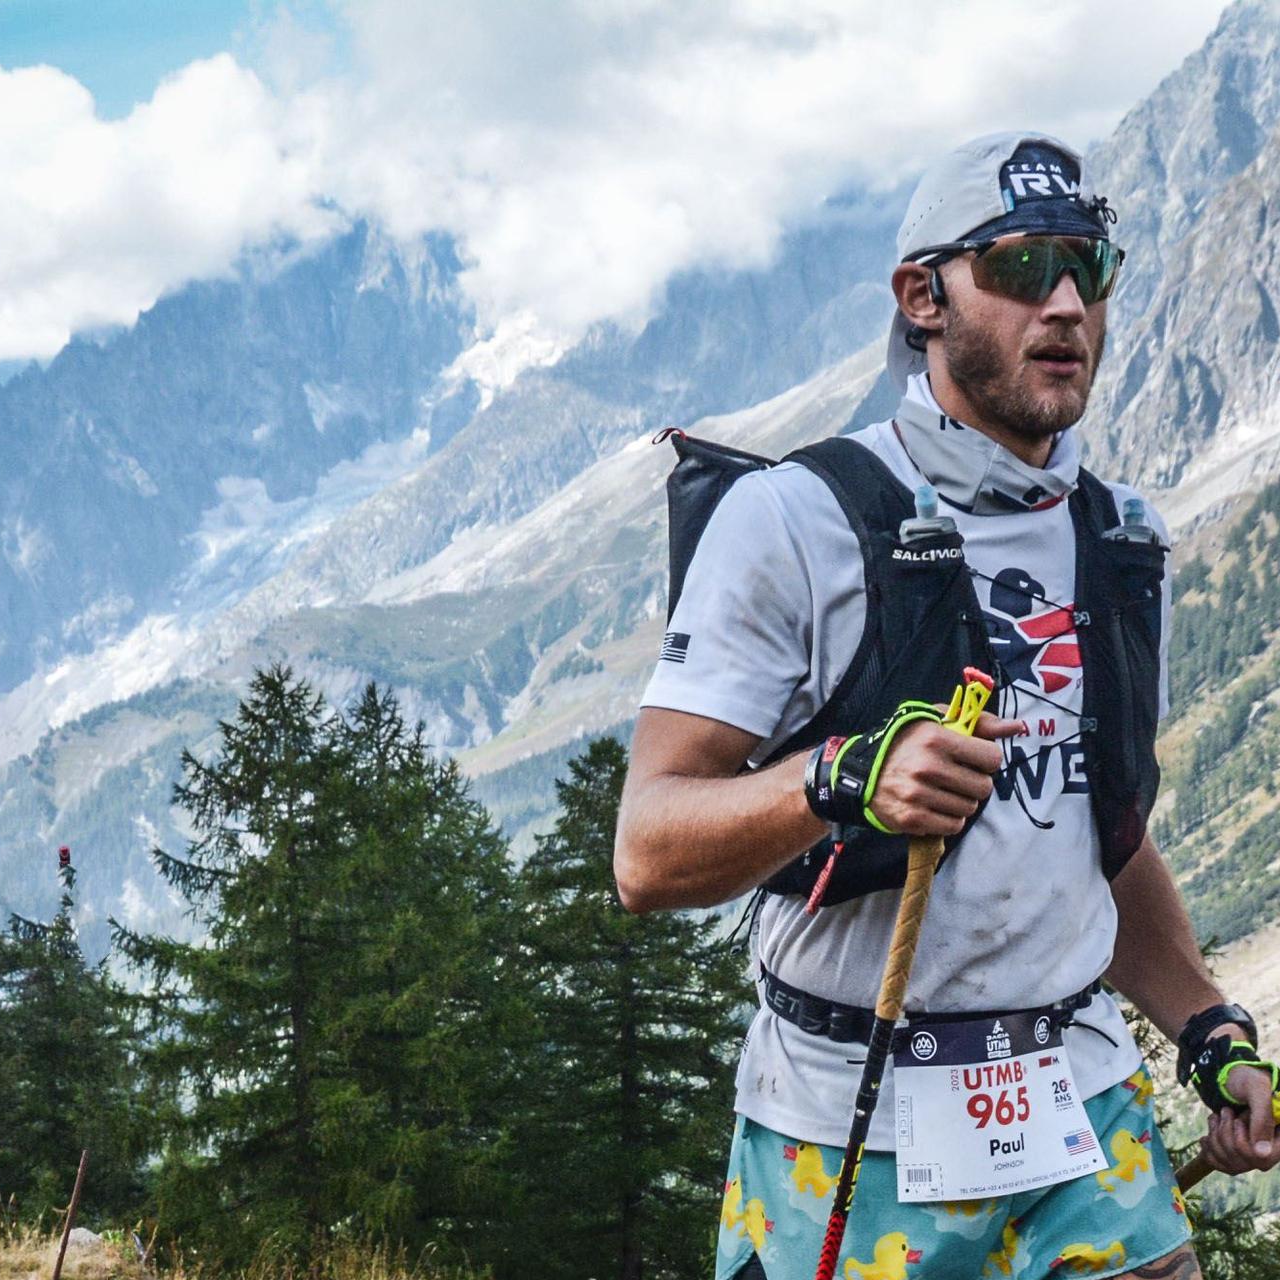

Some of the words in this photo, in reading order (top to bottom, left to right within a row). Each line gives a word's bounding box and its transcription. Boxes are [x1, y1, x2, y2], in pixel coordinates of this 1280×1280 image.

[1007, 163, 1061, 173] TEAM
[1018, 718, 1056, 738] AM
[766, 980, 800, 1013] LET
[987, 1039, 1011, 1051] UTMB
[951, 1069, 959, 1091] 2023
[963, 1061, 1023, 1090] UTMB
[967, 1086, 1030, 1129] 965
[1055, 1094, 1072, 1103] ANS
[989, 1132, 1024, 1156] Paul
[993, 1160, 1024, 1171] JOHNSON
